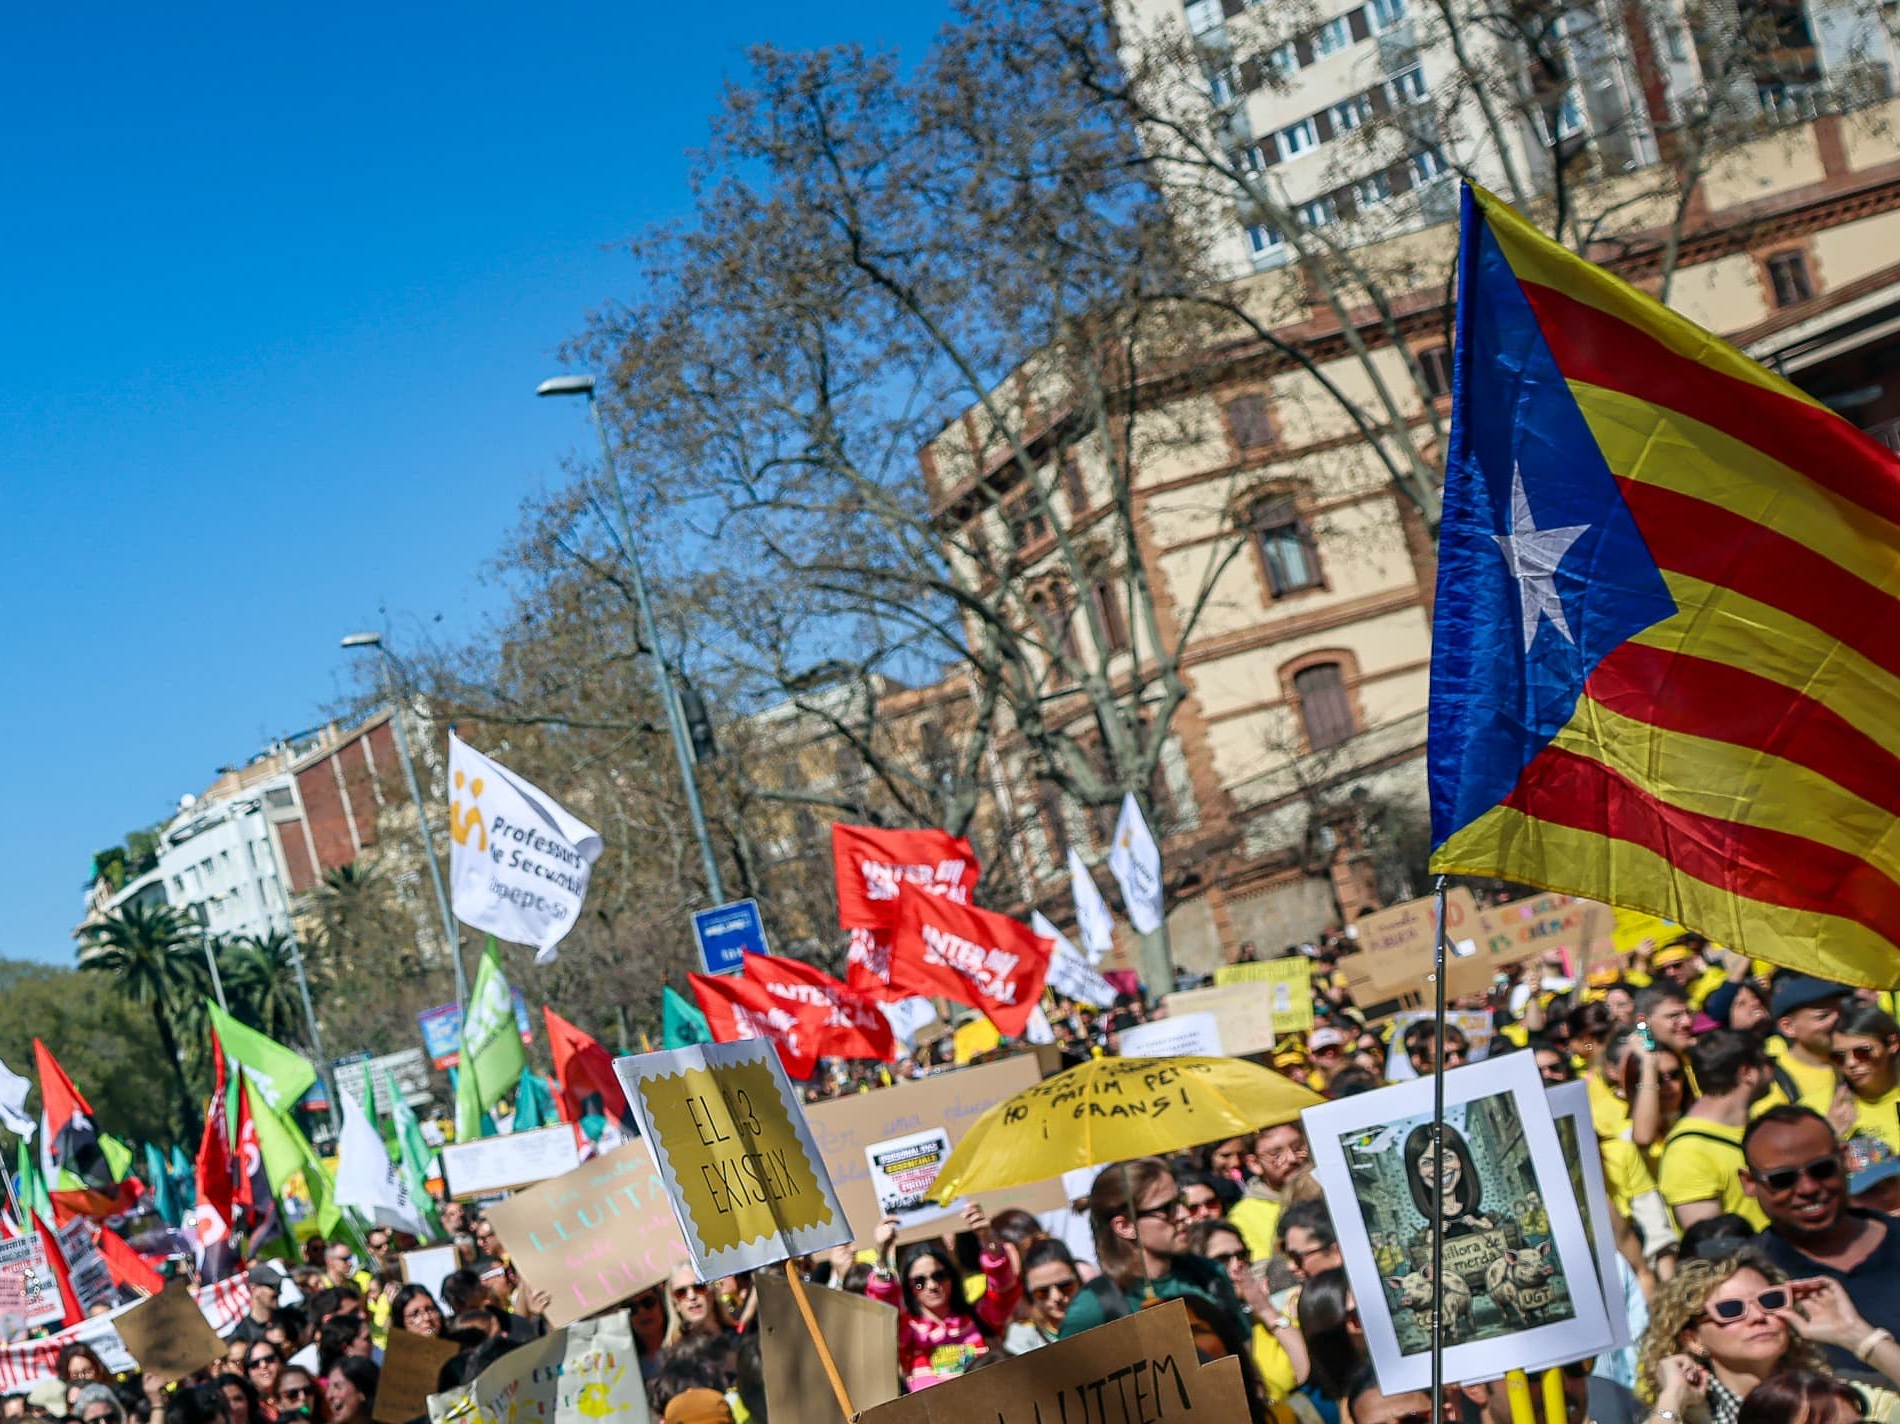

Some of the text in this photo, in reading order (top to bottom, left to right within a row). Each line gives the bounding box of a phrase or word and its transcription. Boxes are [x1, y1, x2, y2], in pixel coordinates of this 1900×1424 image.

[685, 1095, 731, 1146] EL
[528, 1173, 666, 1253] LLUITA
[1442, 1232, 1500, 1262] illora de
[1454, 1251, 1497, 1270] merda
[1522, 1289, 1550, 1305] UGT
